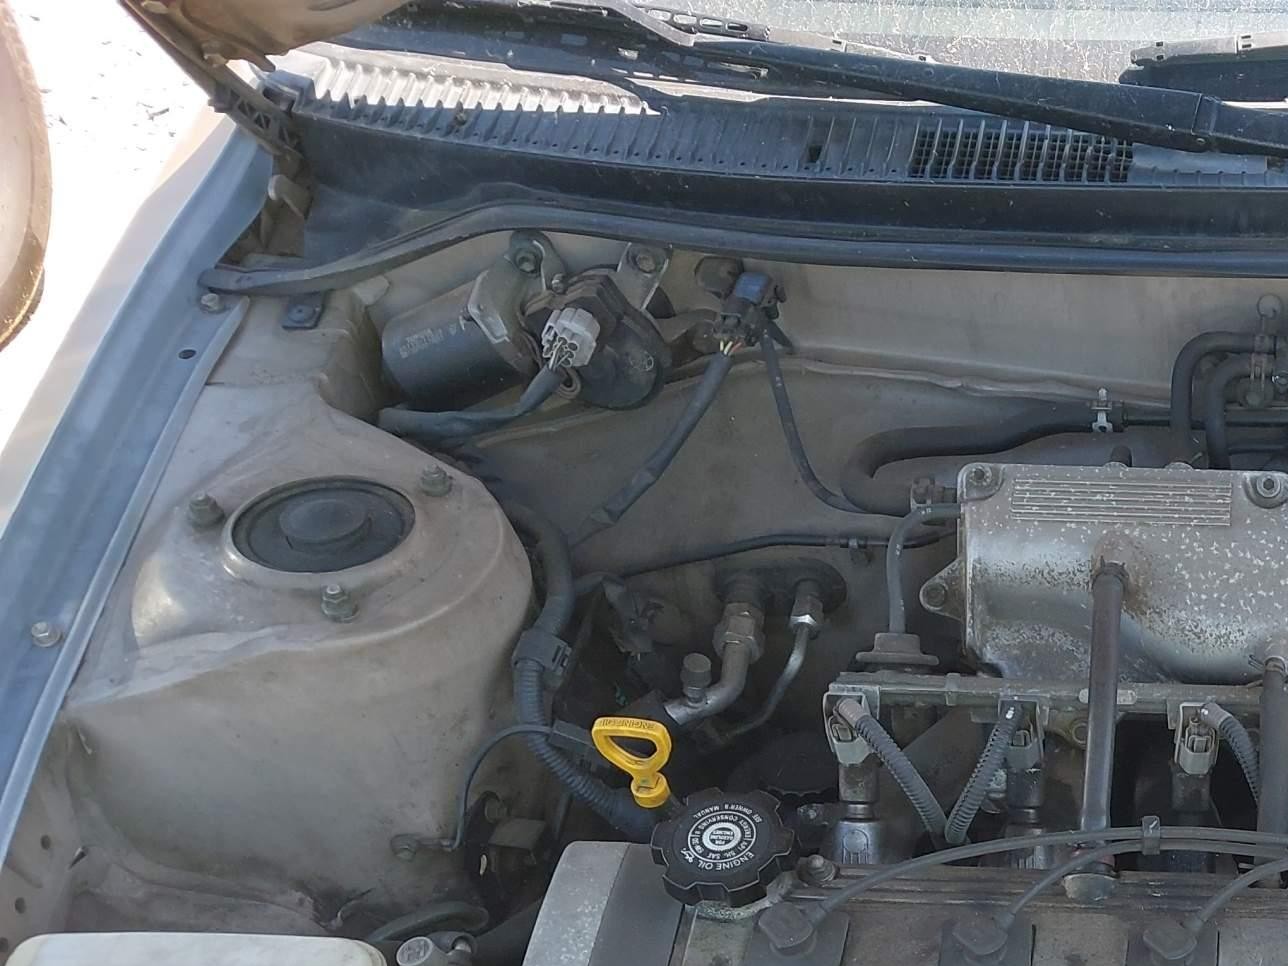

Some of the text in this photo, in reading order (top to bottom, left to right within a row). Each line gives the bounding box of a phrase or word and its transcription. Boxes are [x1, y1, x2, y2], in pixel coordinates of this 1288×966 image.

[693, 805, 720, 819] MANUAL
[698, 851, 755, 871] ENGINE OIL
